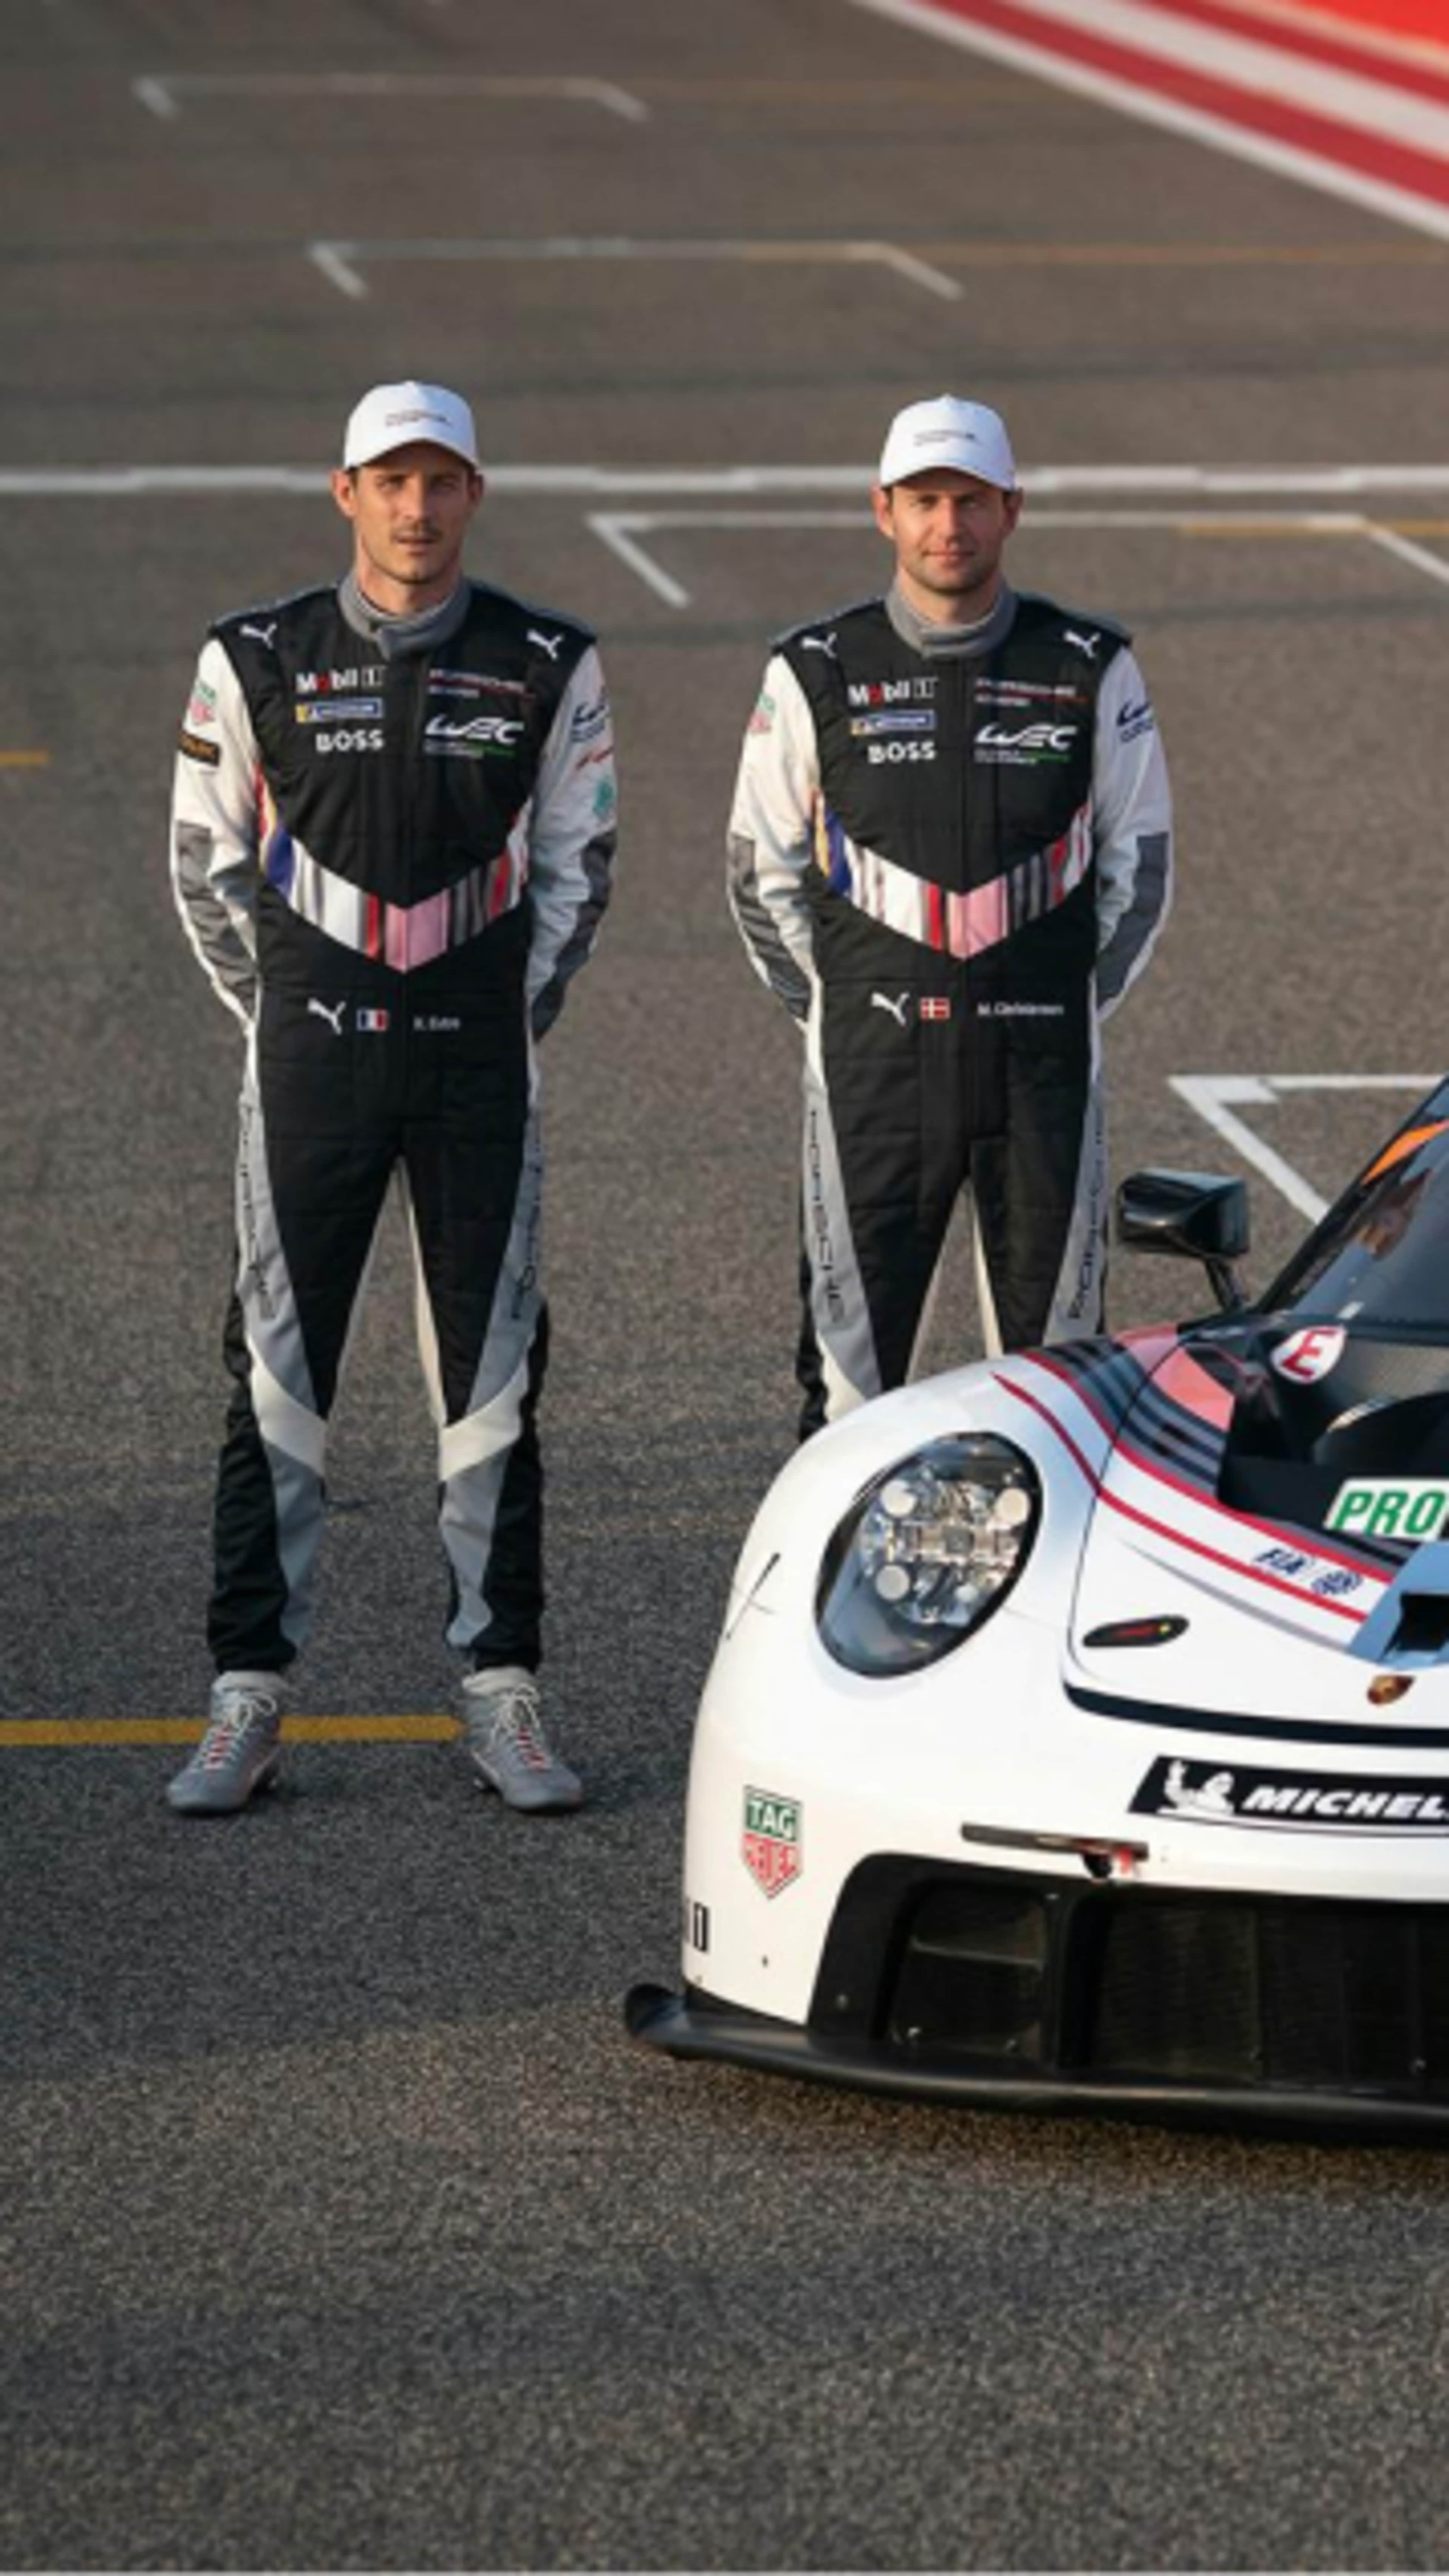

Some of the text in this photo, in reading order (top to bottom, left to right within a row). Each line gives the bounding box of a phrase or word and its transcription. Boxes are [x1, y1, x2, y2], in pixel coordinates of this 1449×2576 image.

[296, 669, 358, 694] Mobil
[848, 681, 909, 706] Mobil
[315, 730, 384, 752] BOSS
[425, 715, 524, 744] WEC
[974, 723, 1078, 750] WEC
[868, 741, 935, 764] BOSS
[1282, 1328, 1338, 1378] E
[1334, 1490, 1446, 1535] PRO
[1242, 1785, 1449, 1818] MICHEL
[748, 1799, 795, 1840] TAG
